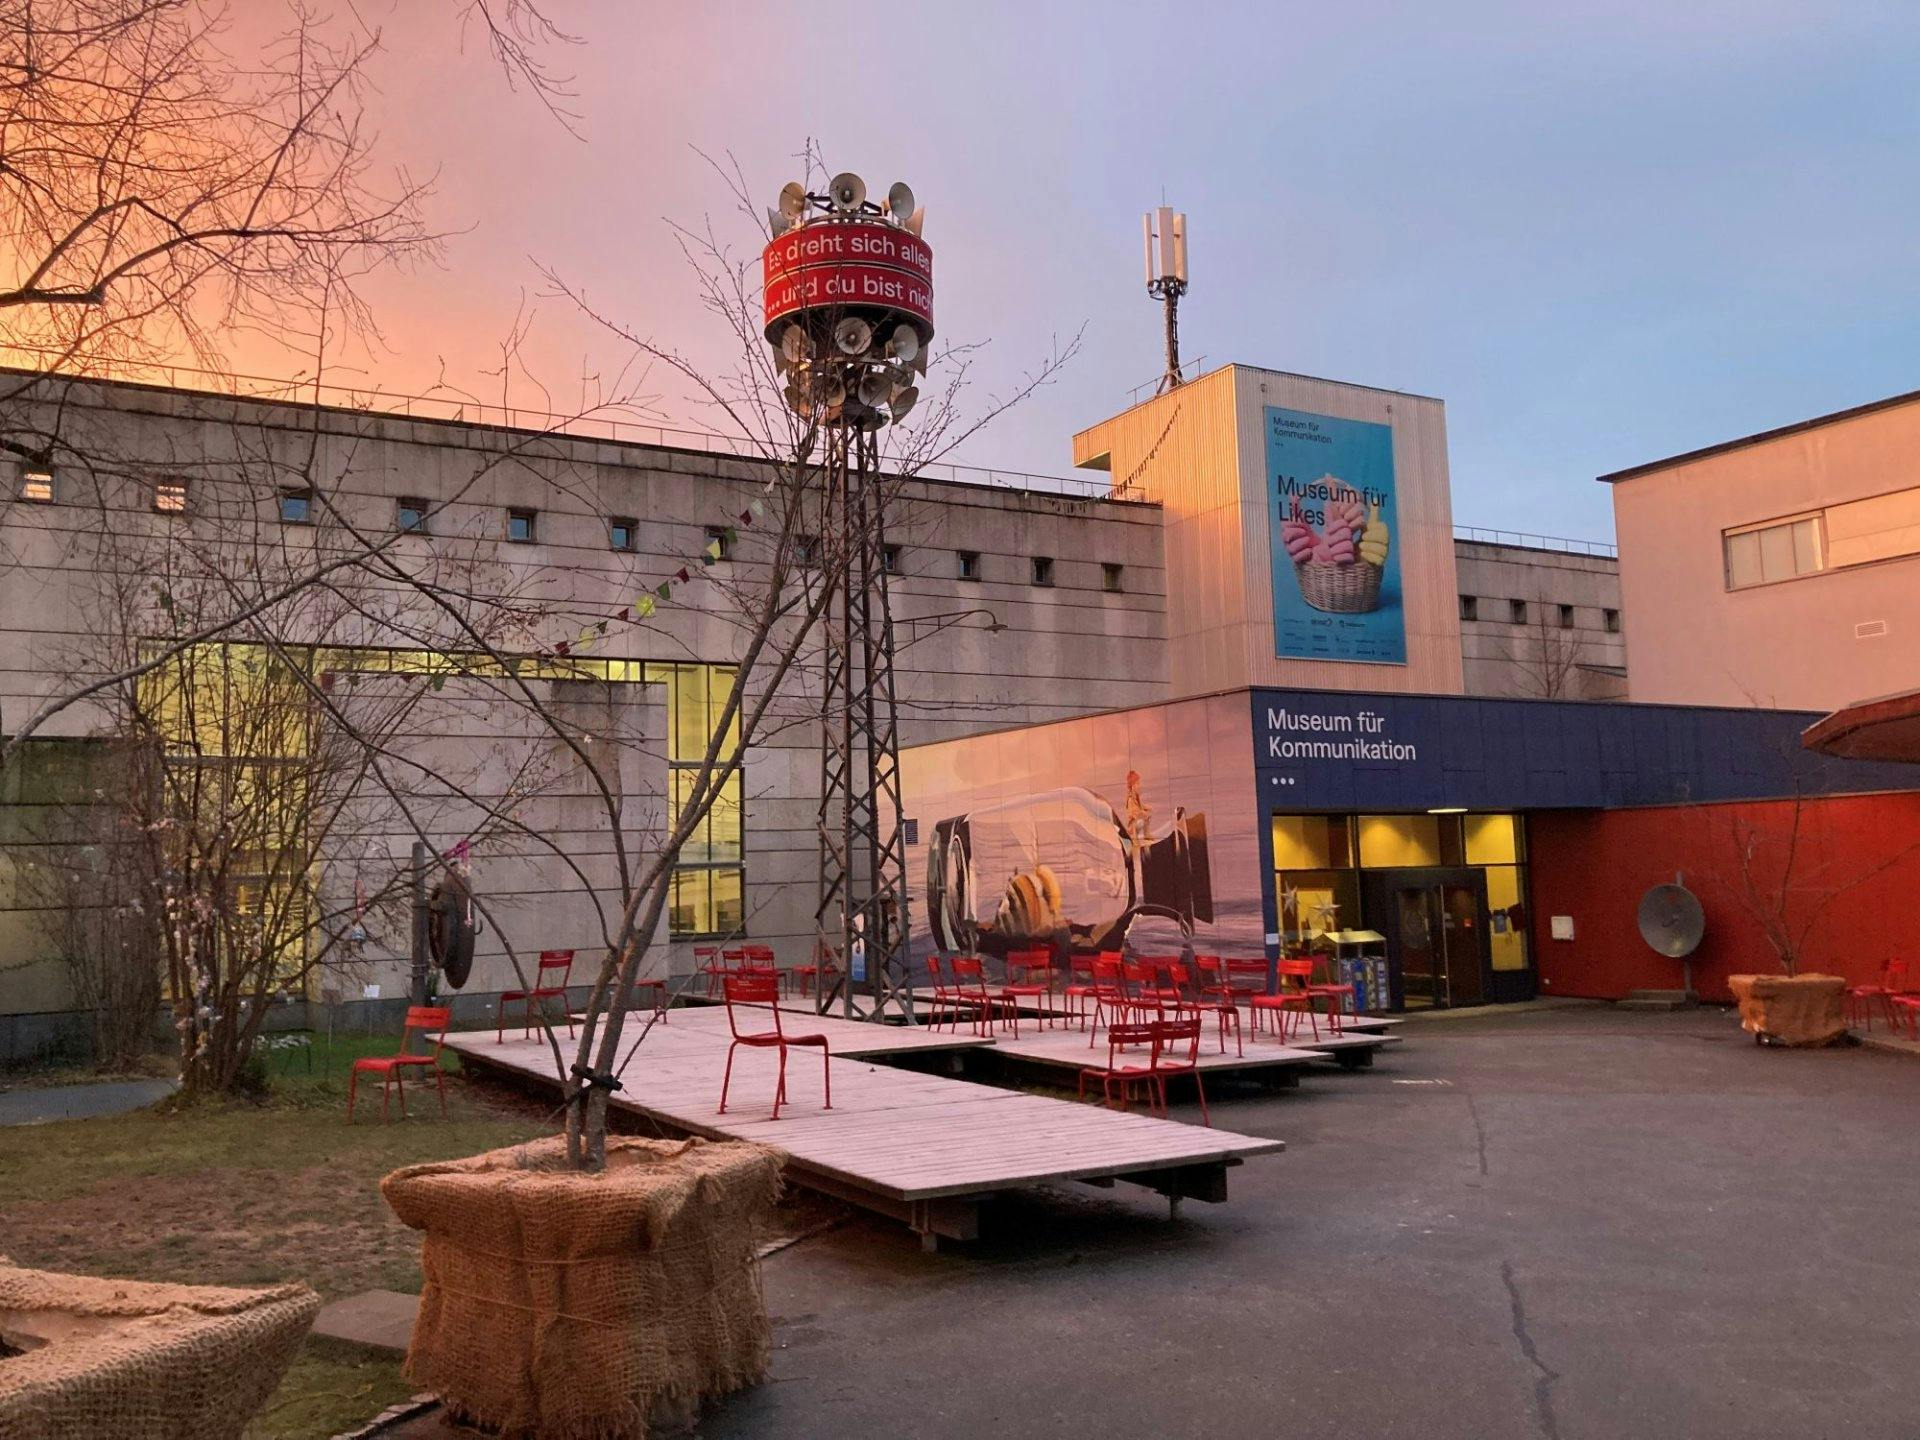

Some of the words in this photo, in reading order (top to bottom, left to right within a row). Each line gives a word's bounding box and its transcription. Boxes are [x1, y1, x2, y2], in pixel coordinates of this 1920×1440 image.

[768, 251, 782, 272] Es
[786, 234, 843, 260] dreht
[851, 233, 895, 256] sich
[901, 244, 930, 273] alles
[825, 274, 855, 294] du
[863, 274, 904, 300] bist
[1273, 416, 1307, 429] Museum
[1308, 421, 1320, 431] für
[1273, 427, 1333, 444] Kommunikation
[1277, 475, 1357, 504] Museum
[1362, 486, 1389, 508] für
[1278, 501, 1326, 526] Likes
[1267, 708, 1352, 732] Museum
[1357, 711, 1386, 733] für
[1269, 736, 1416, 761] Kommunikation
